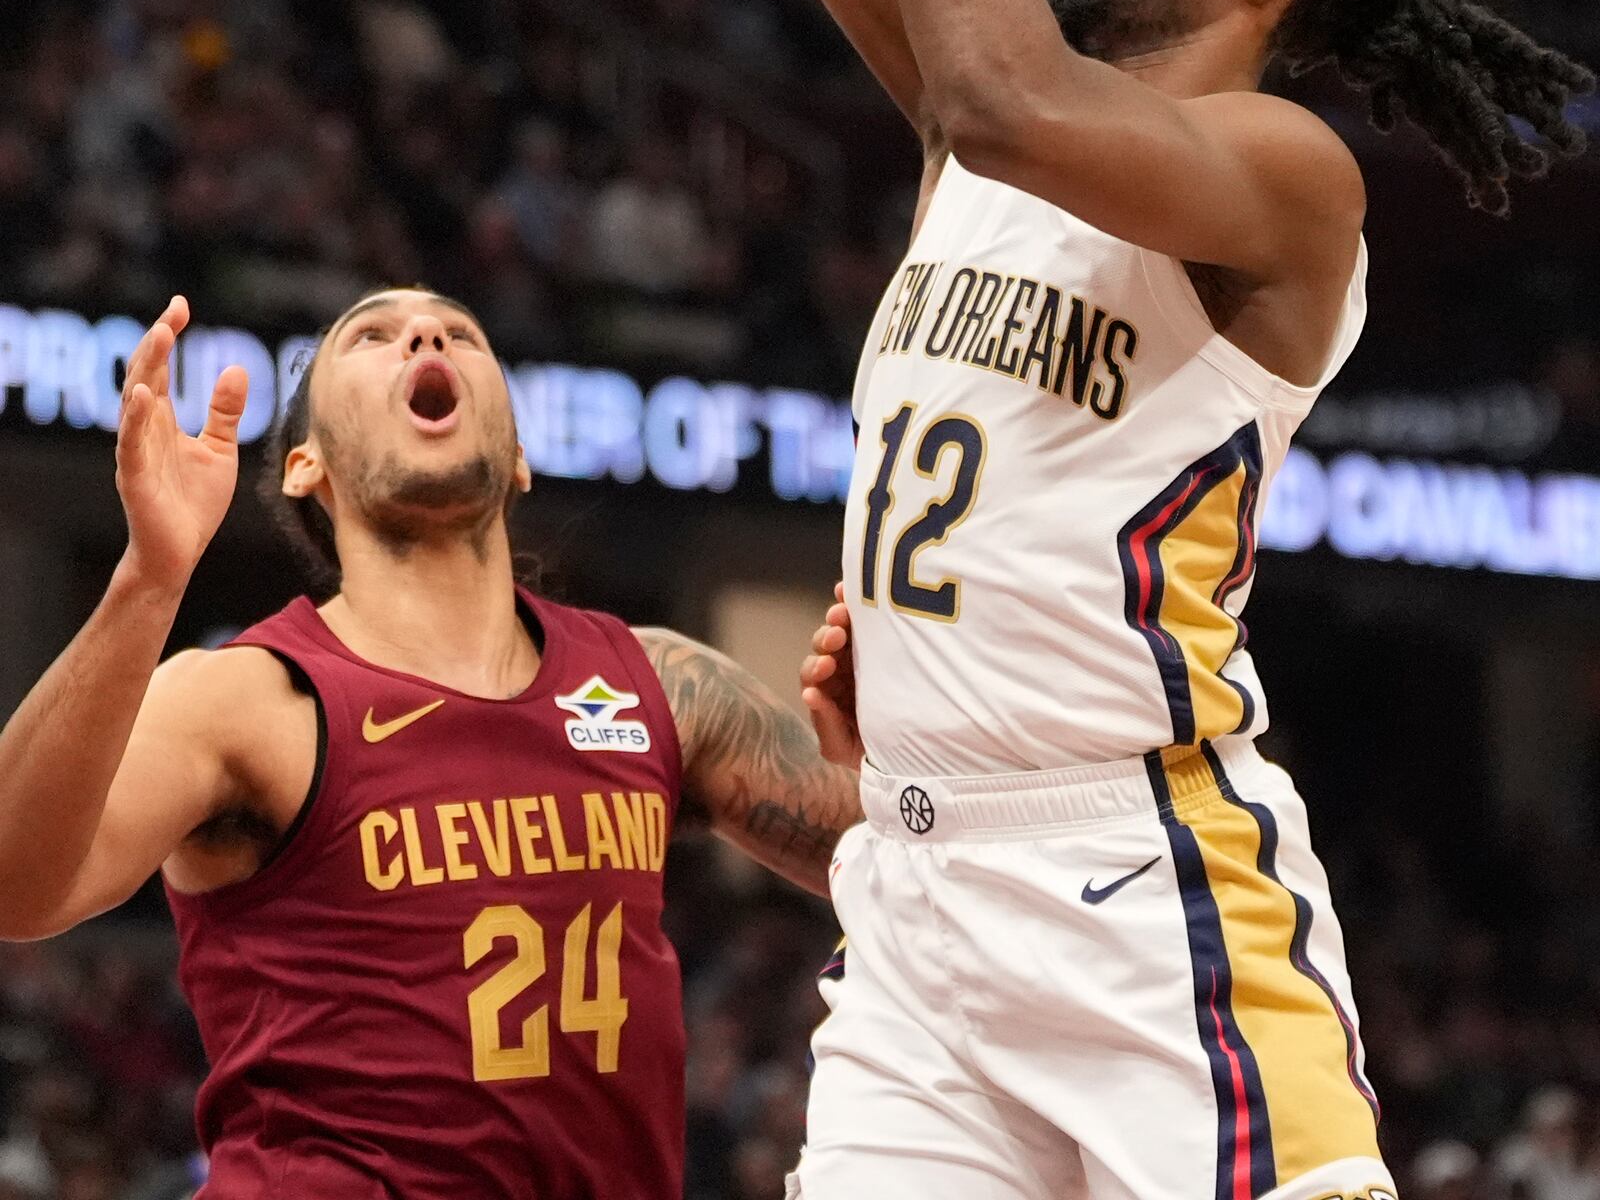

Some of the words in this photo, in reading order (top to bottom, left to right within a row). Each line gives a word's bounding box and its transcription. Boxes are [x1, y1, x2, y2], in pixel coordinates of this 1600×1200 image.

[876, 261, 945, 356] EW
[924, 266, 1141, 423] ORLEANS
[643, 375, 764, 494] OF
[860, 401, 989, 625] 12
[569, 725, 647, 747] CLIFFS
[358, 791, 668, 892] CLEVELAND
[462, 900, 629, 1083] 24
